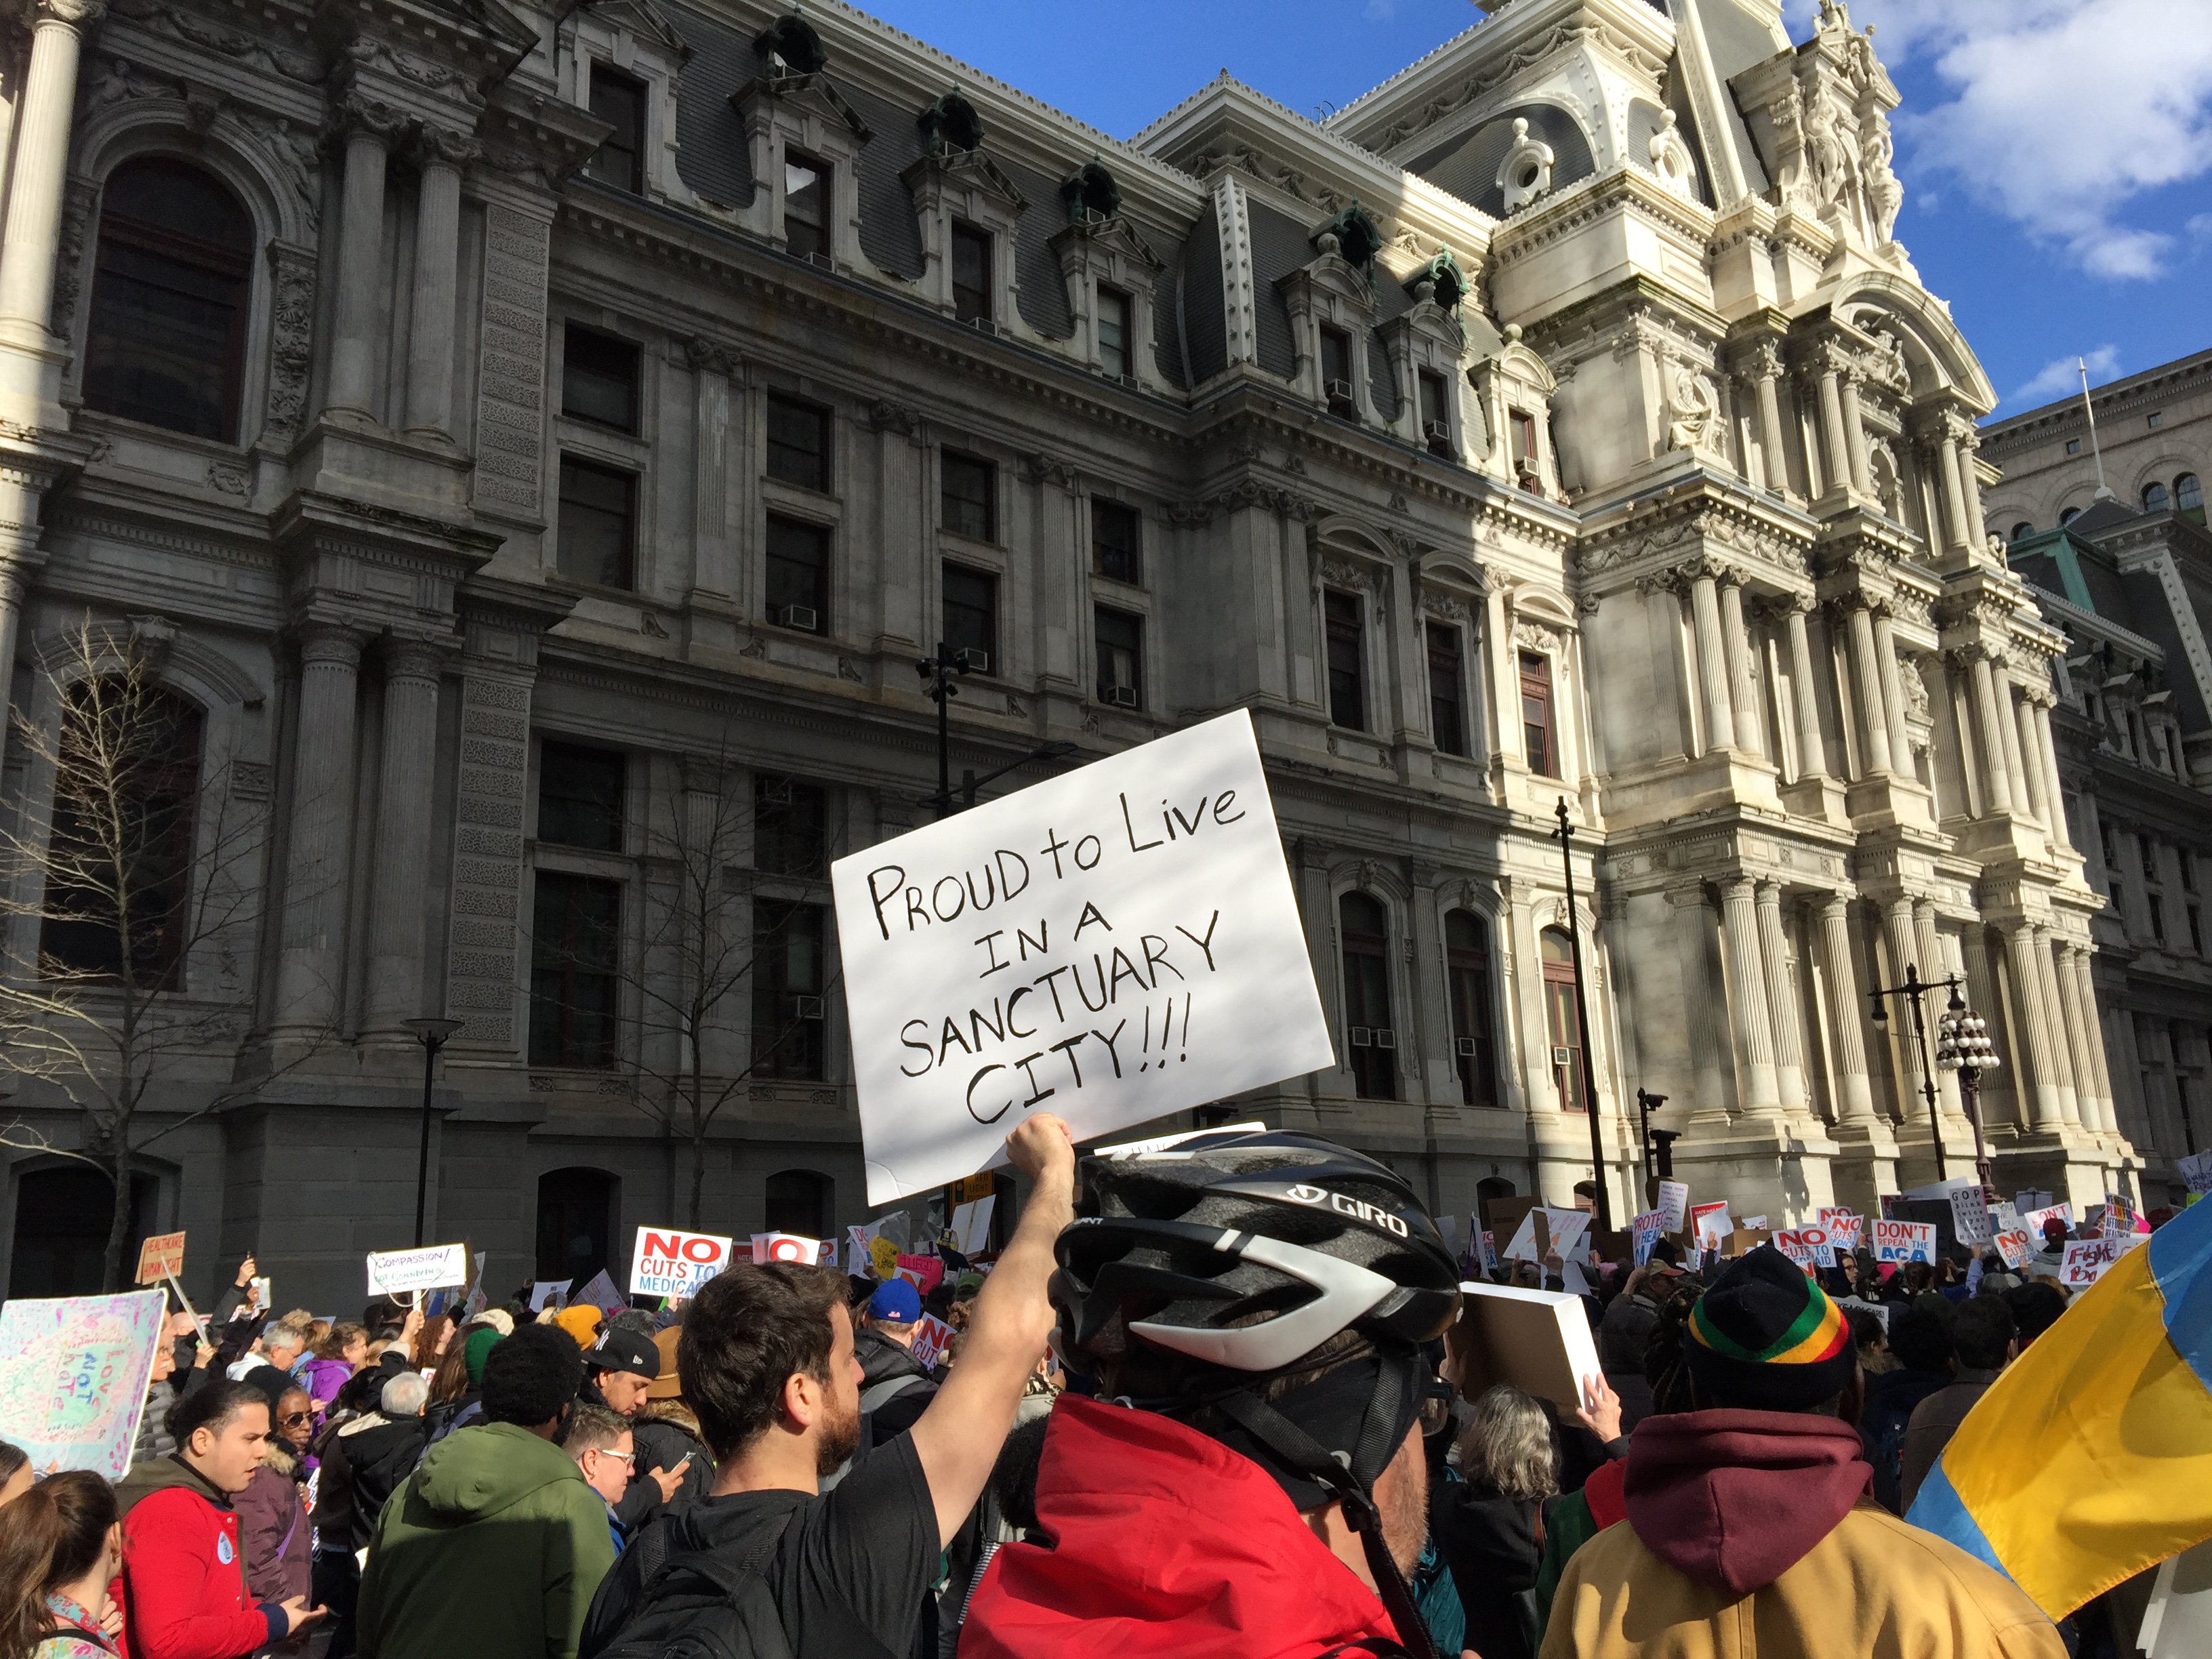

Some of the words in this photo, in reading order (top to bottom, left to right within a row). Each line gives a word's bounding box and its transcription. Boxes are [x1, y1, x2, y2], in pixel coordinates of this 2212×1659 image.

[867, 850, 1029, 940] PROUD
[1040, 829, 1101, 880] to
[1120, 790, 1246, 853] Live
[974, 919, 1048, 979] IN
[1074, 901, 1112, 942] A
[900, 910, 1219, 1077] SANCTUARY
[966, 992, 1191, 1124] CITY!!!
[1952, 1189, 1980, 1201] GOP
[1332, 1193, 1408, 1238] GIRO
[1831, 1218, 1861, 1231] NO
[1778, 1229, 1826, 1247] NO
[1829, 1230, 1852, 1240] CUTS
[1877, 1223, 1929, 1241] DON'T
[1997, 1230, 2028, 1249] NO
[146, 1235, 183, 1253] HEALTHCARE
[643, 1232, 721, 1263] NO
[1782, 1246, 1811, 1258] CUTS
[1814, 1245, 1829, 1256] TO
[1878, 1238, 1908, 1248] REPEAL
[1912, 1241, 1929, 1250] THE
[2005, 1245, 2026, 1258] CUTS
[1881, 1247, 1927, 1262] ACA
[2068, 1243, 2114, 1267] Fight
[640, 1258, 687, 1278] CUTS
[694, 1264, 716, 1281] TO
[913, 1340, 938, 1365] CUT
